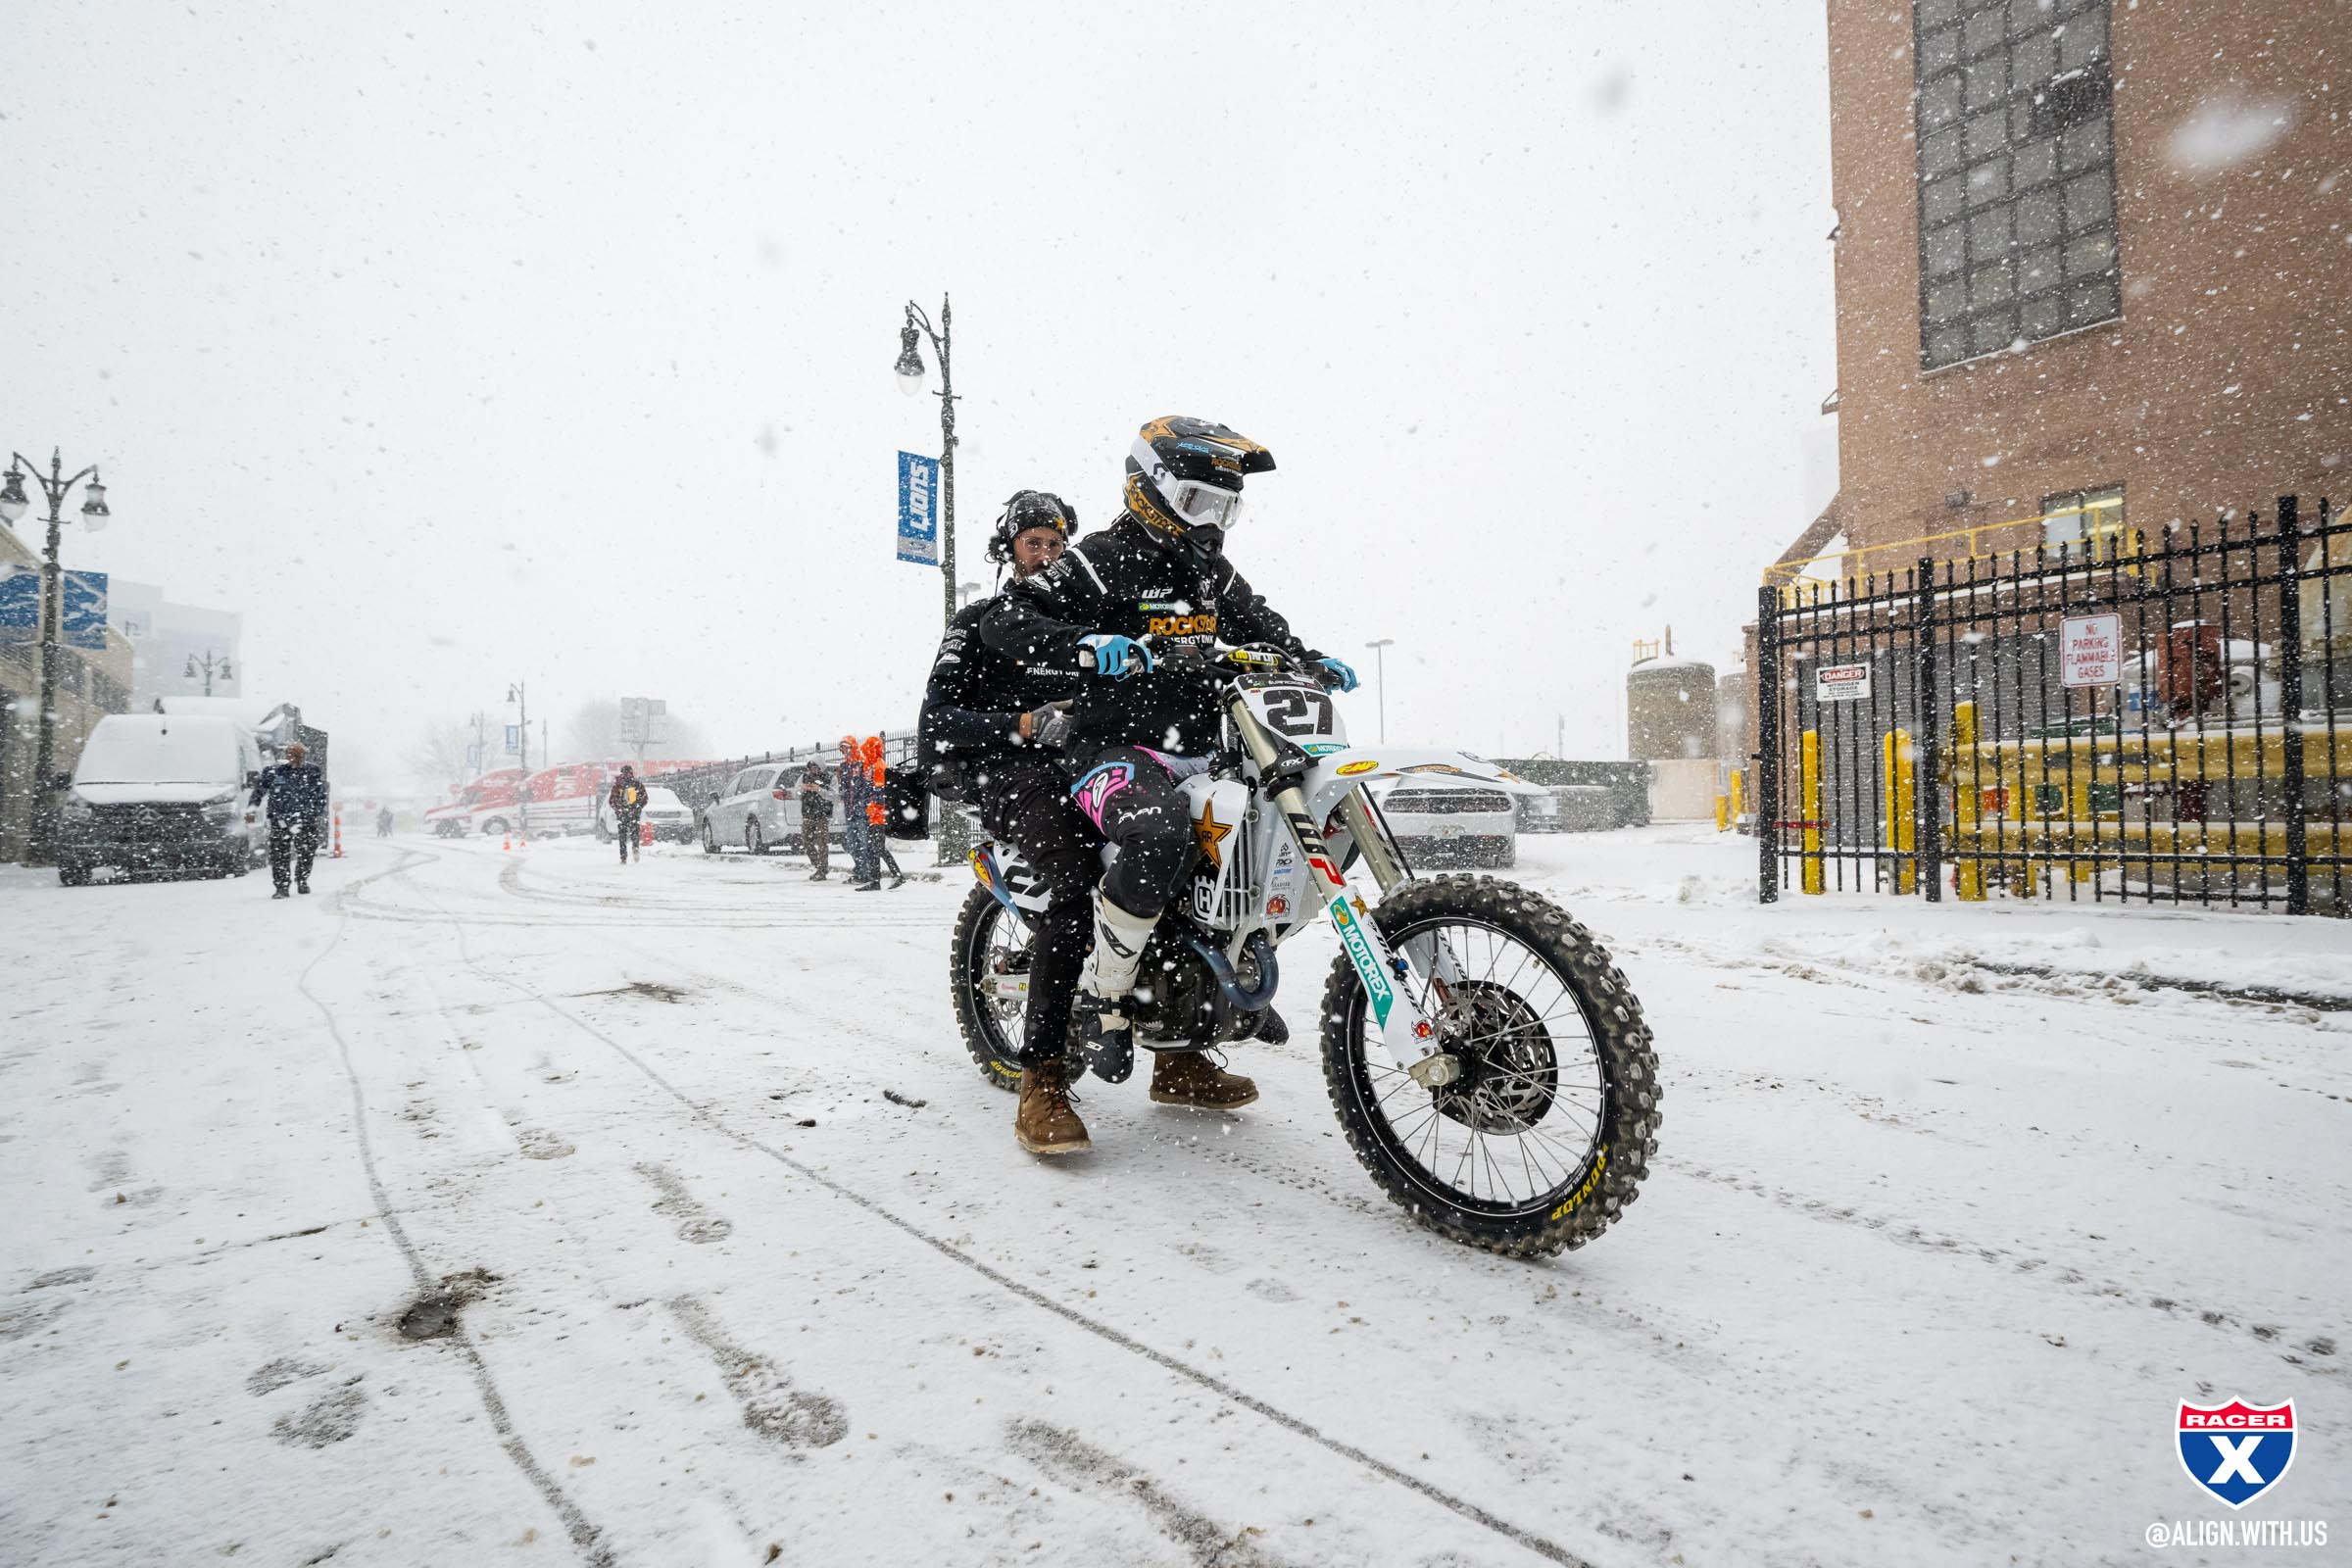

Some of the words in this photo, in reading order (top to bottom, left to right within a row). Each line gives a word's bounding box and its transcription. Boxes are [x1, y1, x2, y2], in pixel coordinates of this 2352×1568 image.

[1149, 614, 1217, 636] ROCKSTAR
[2072, 636, 2109, 650] PARKING
[2067, 650, 2117, 665] FLAMMABLE
[1824, 668, 1863, 680] DANGER
[2078, 665, 2105, 678] GASES
[1263, 689, 1334, 736] 27
[1343, 924, 1390, 1002] MOTOREX
[1551, 1156, 1606, 1221] DUNLOP
